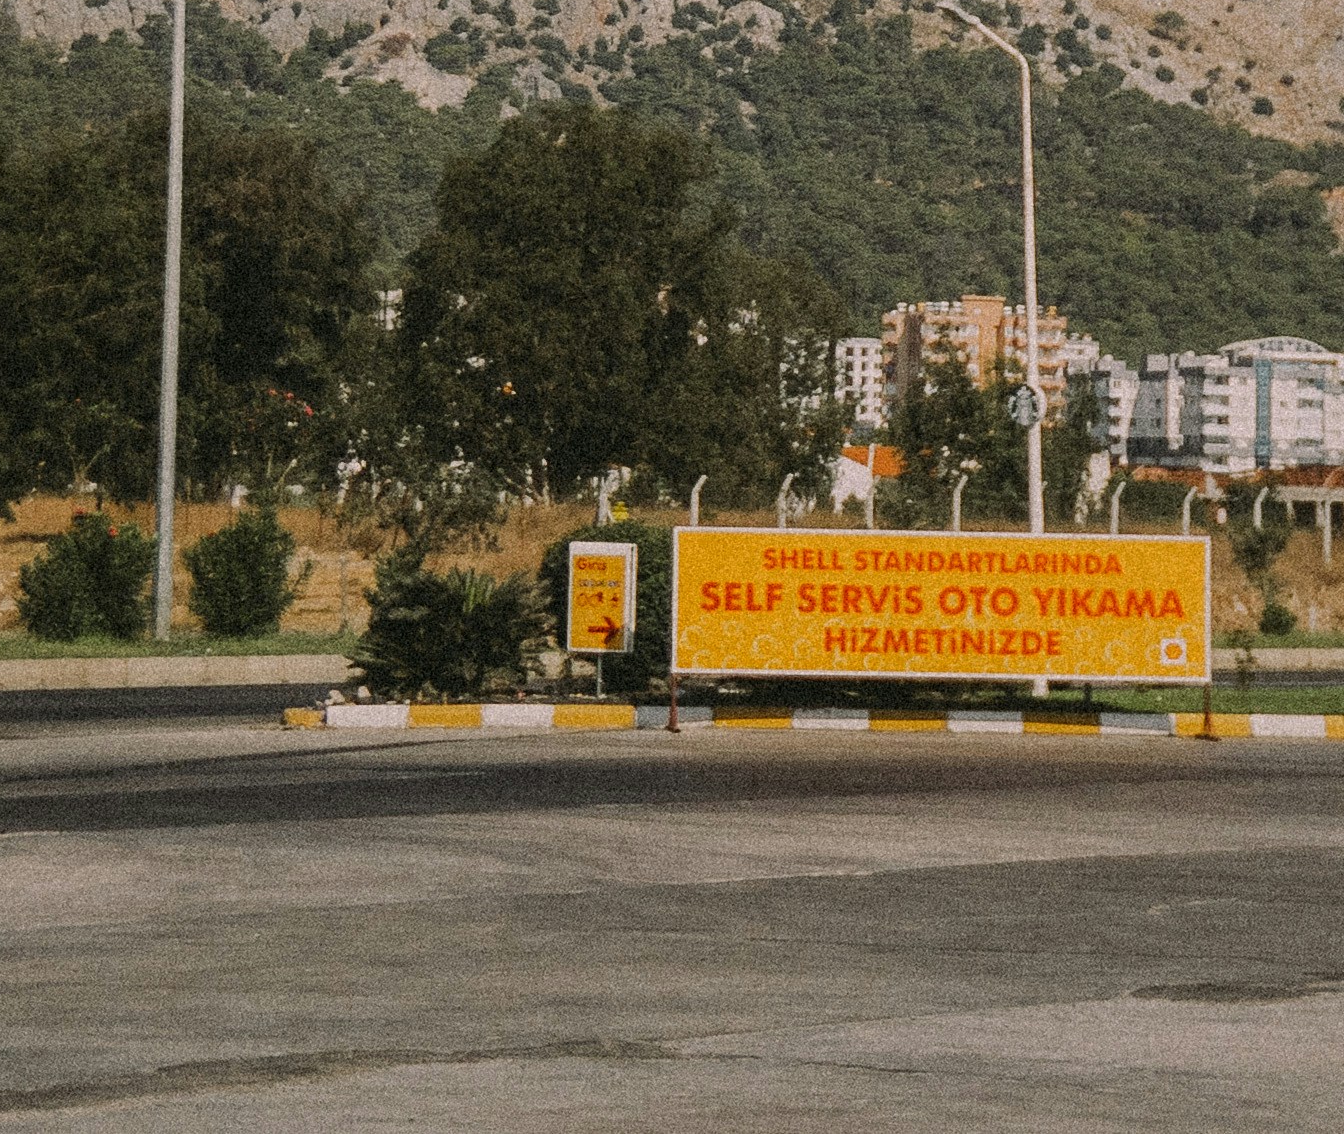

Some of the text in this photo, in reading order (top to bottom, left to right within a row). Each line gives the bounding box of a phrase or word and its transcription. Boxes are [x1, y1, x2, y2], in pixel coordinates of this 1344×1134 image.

[762, 548, 1123, 575] SHELL STANDARTLARINDA
[700, 581, 783, 612] SELF
[939, 586, 1019, 617] OTO
[1033, 588, 1185, 619] YIKAMA
